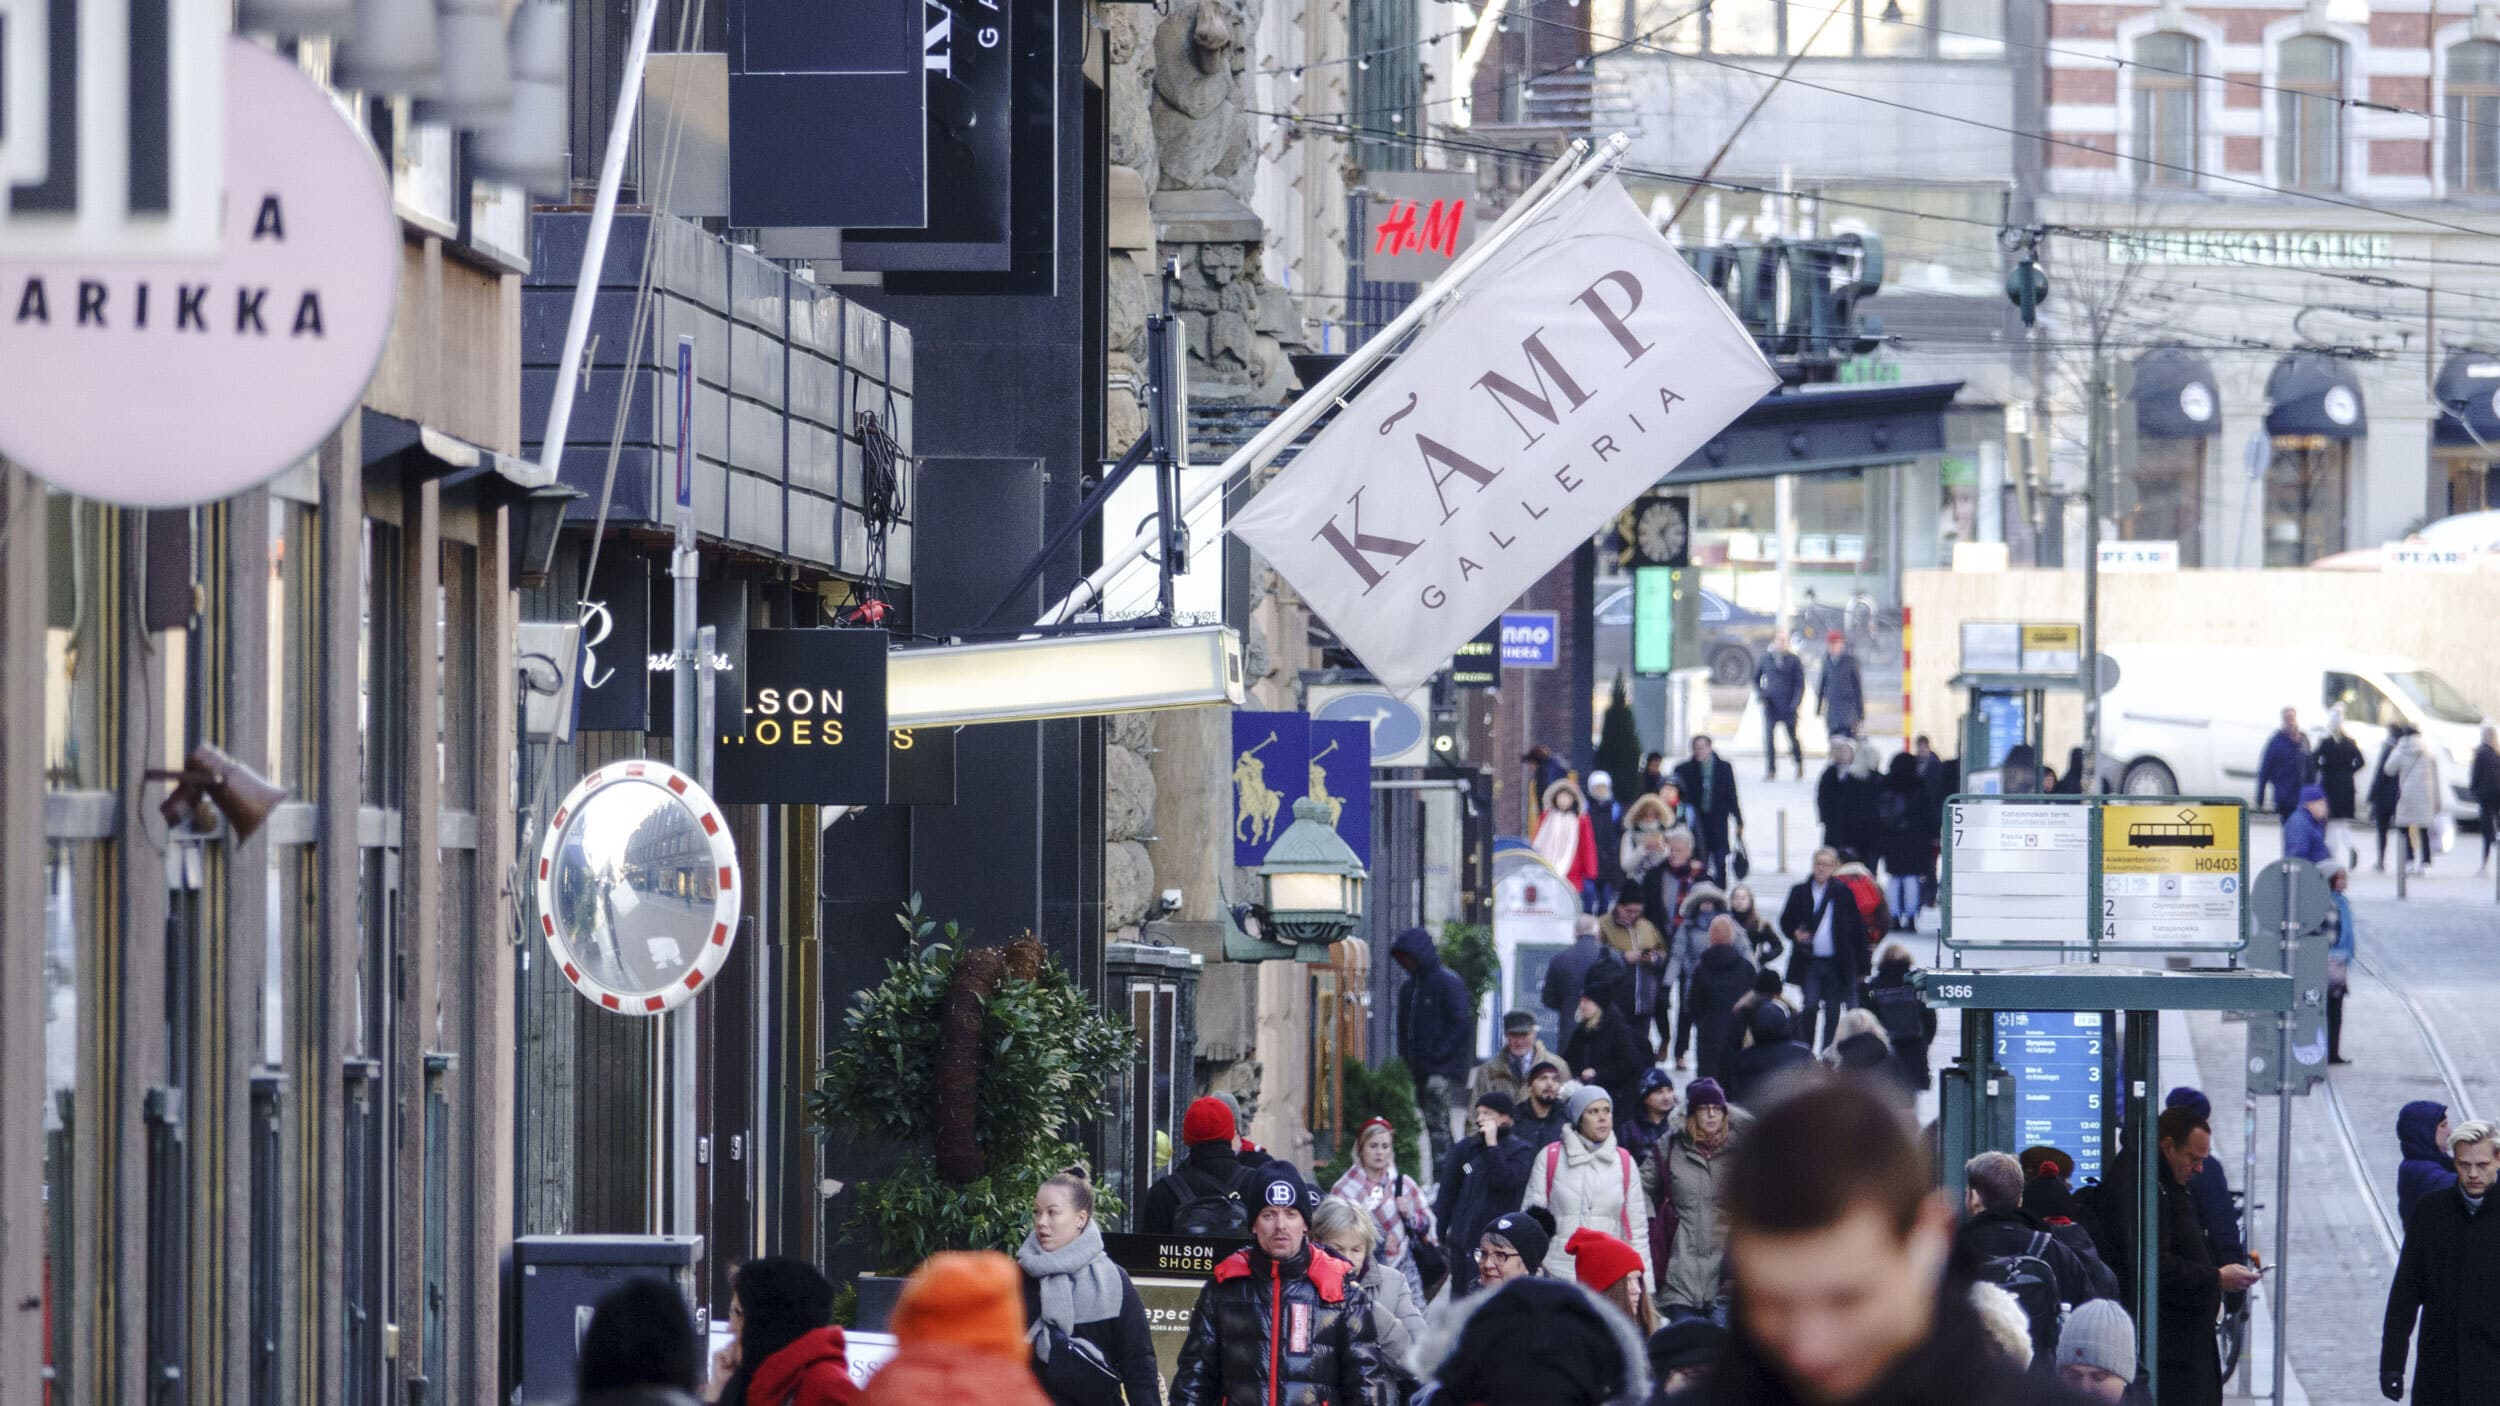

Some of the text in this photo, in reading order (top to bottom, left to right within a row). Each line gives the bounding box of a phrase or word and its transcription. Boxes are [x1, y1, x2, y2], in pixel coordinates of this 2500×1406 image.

[1375, 198, 1465, 258] H&M
[1421, 387, 1685, 609] GALLERIA
[744, 688, 843, 714] SON
[1954, 807, 1964, 824] 5
[1954, 830, 1964, 847] 7
[2195, 857, 2238, 872] H0403
[2104, 899, 2115, 917] 2
[2104, 922, 2116, 940] 4
[1937, 985, 1973, 998] 1366
[1998, 1040, 2100, 1055] 2 2
[2088, 1067, 2100, 1082] 3
[2088, 1094, 2100, 1109] 5
[1159, 1244, 1214, 1257] NILSON
[1159, 1256, 1213, 1270] SHOES
